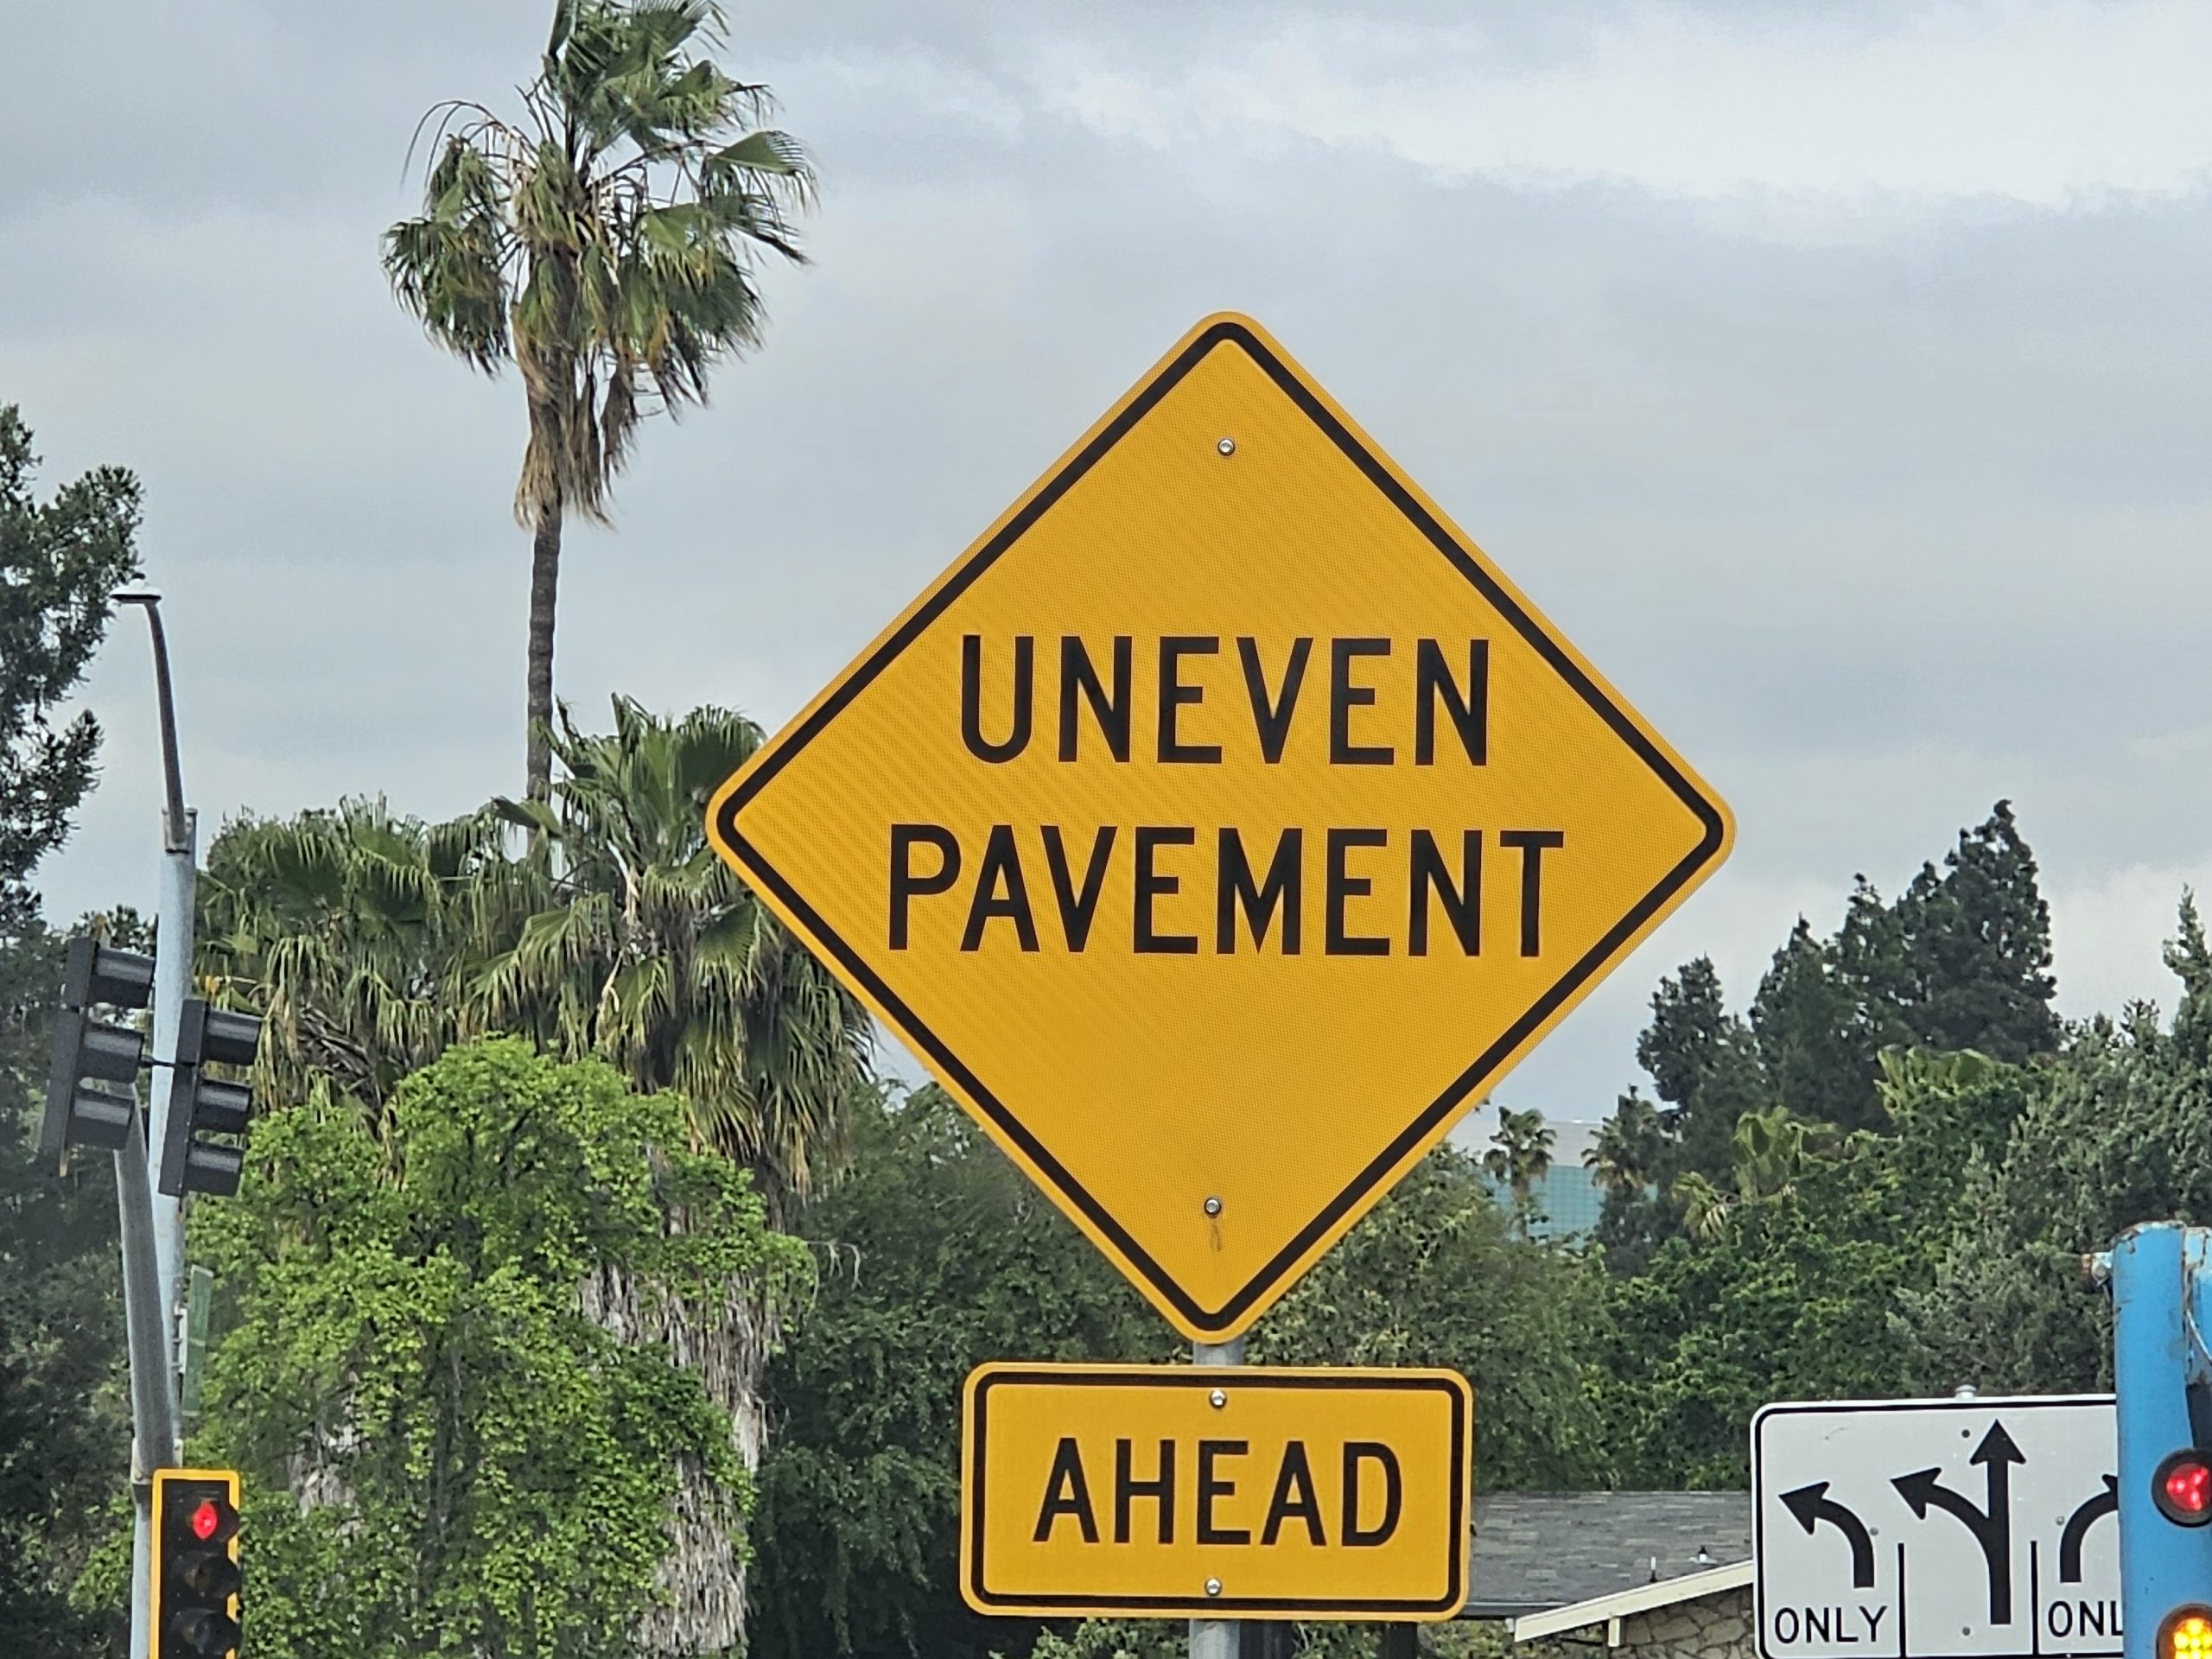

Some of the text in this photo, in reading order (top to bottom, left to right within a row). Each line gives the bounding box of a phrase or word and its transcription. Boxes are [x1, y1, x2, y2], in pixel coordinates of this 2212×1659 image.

[961, 634, 1490, 766] UNEVEN
[888, 823, 1565, 958] PAVEMENT
[1033, 1437, 1402, 1548] AHEAD
[1774, 1605, 1888, 1644] ONLY
[2047, 1599, 2123, 1638] ONL
